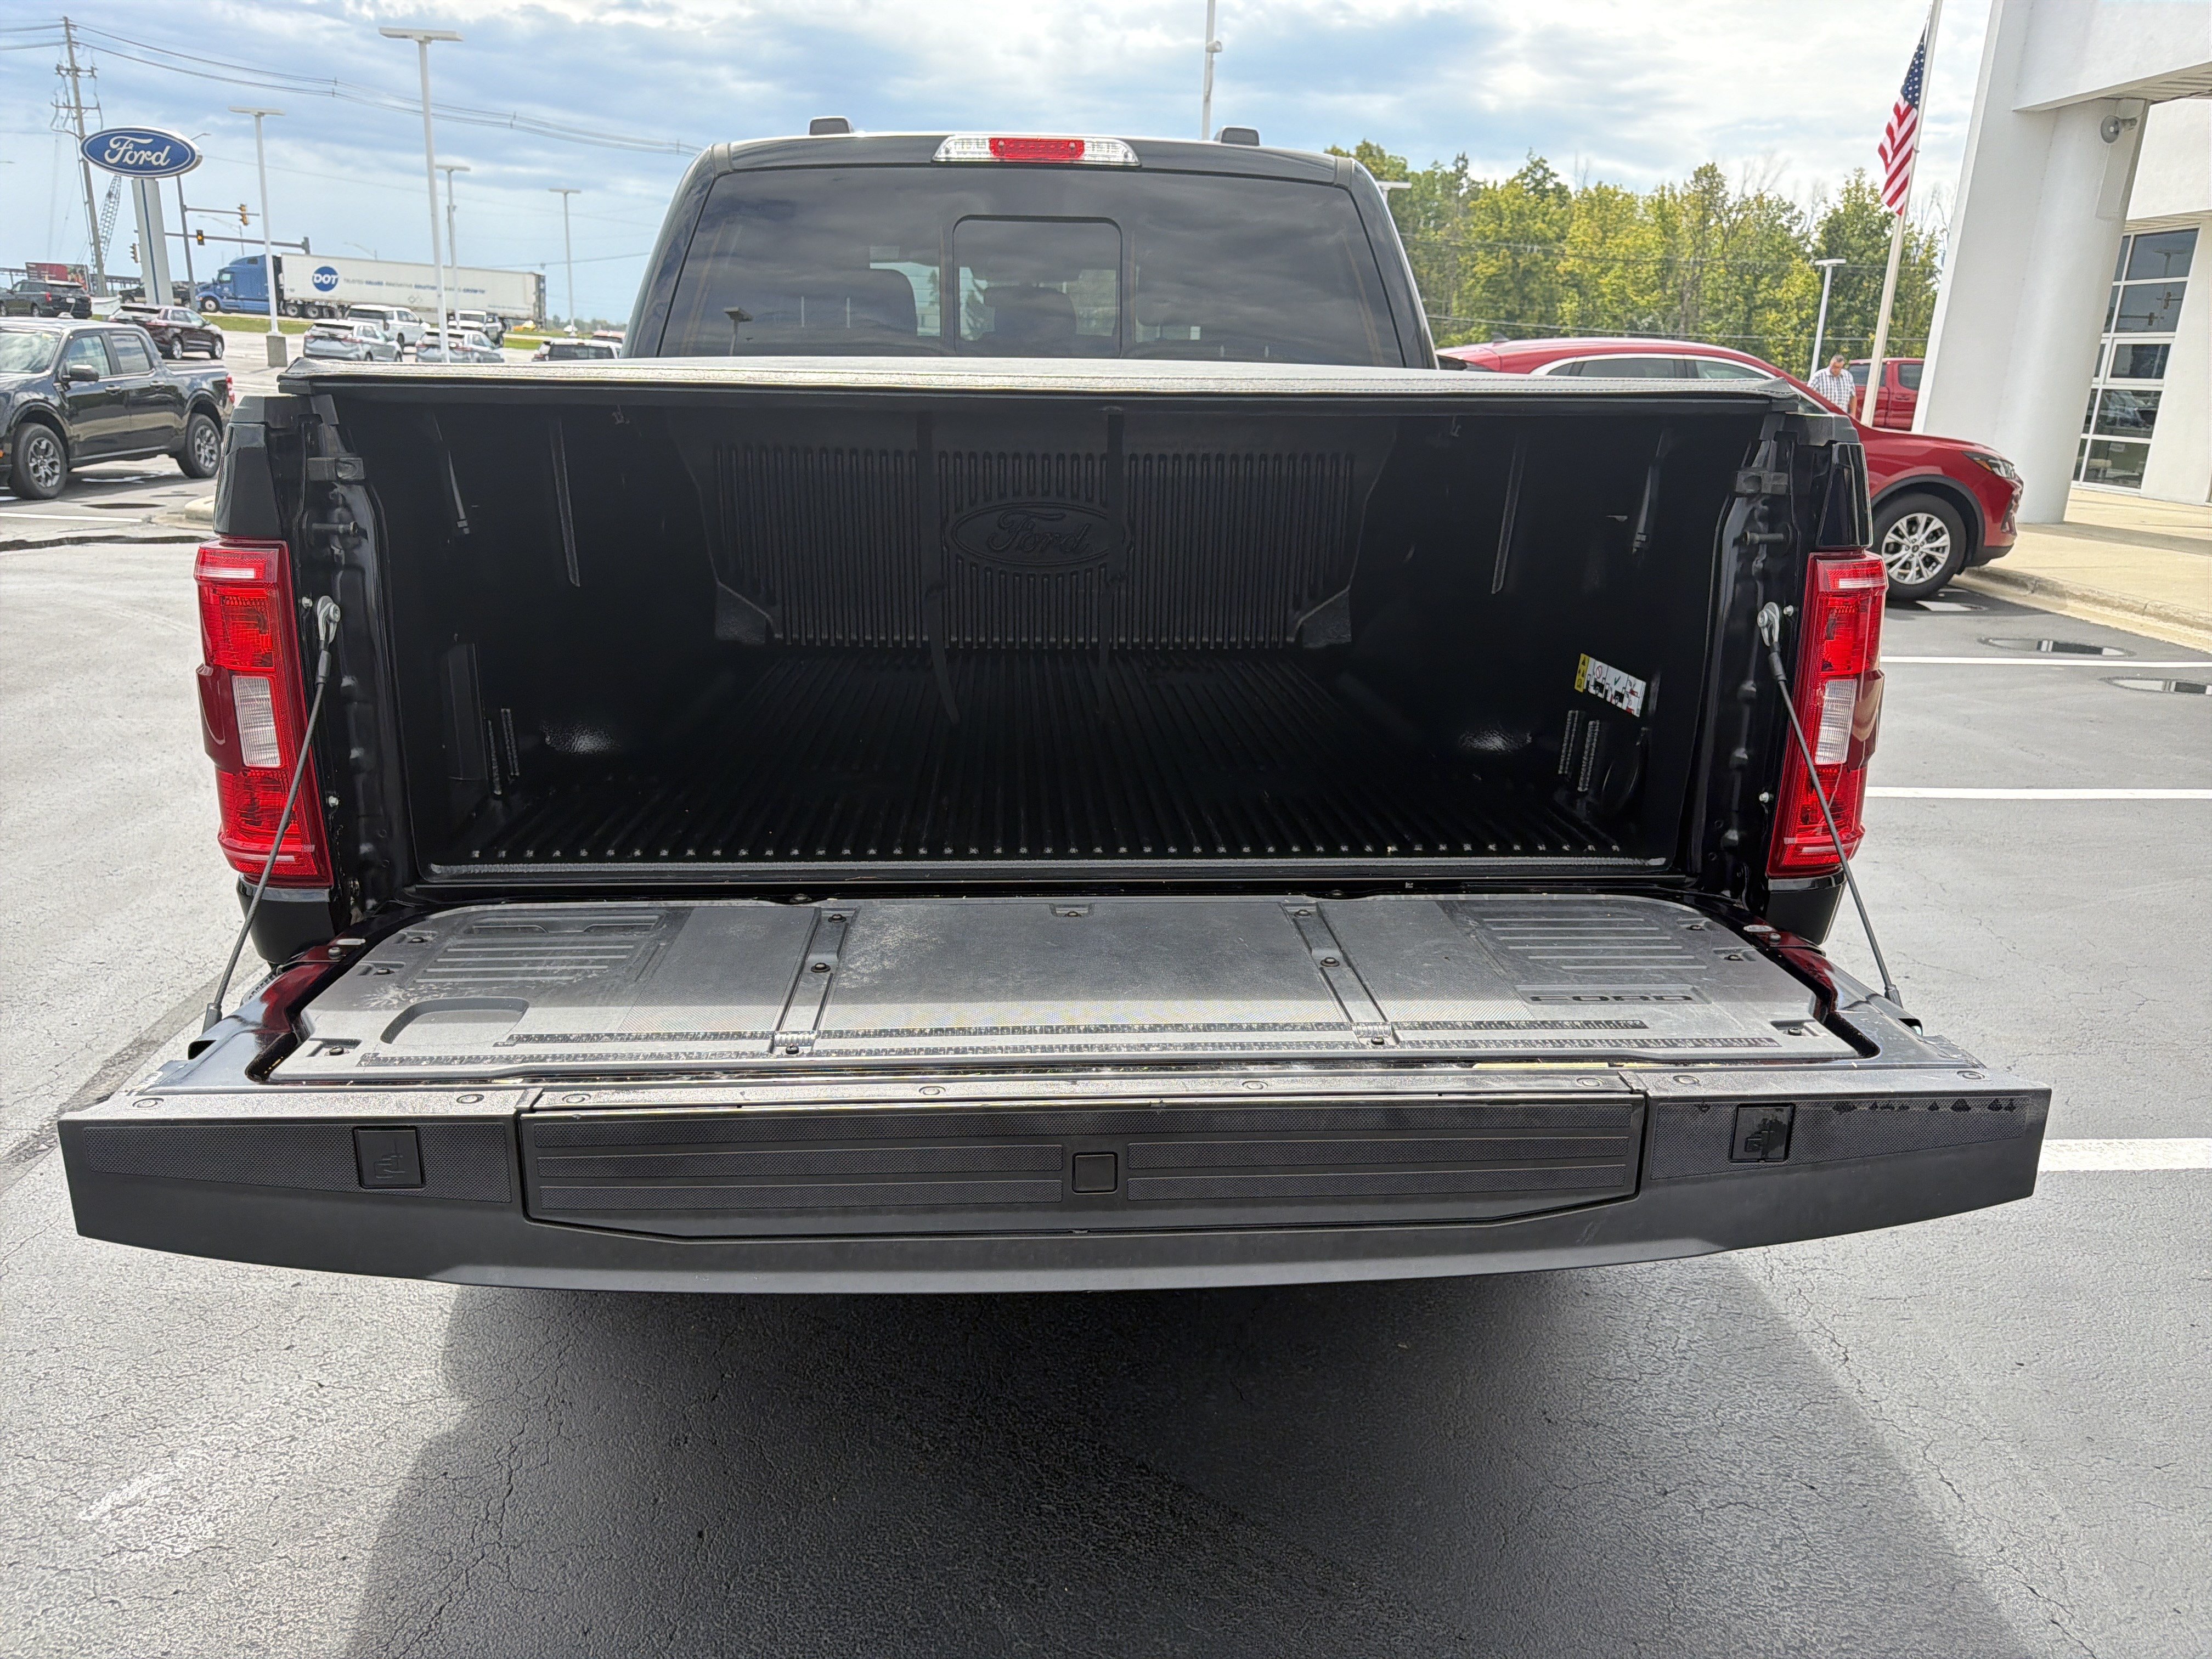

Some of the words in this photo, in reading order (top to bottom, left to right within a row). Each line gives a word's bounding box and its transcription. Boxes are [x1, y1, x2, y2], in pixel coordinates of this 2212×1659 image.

[104, 136, 171, 166] Ford
[313, 273, 338, 284] DOT
[989, 510, 1091, 551] Ford
